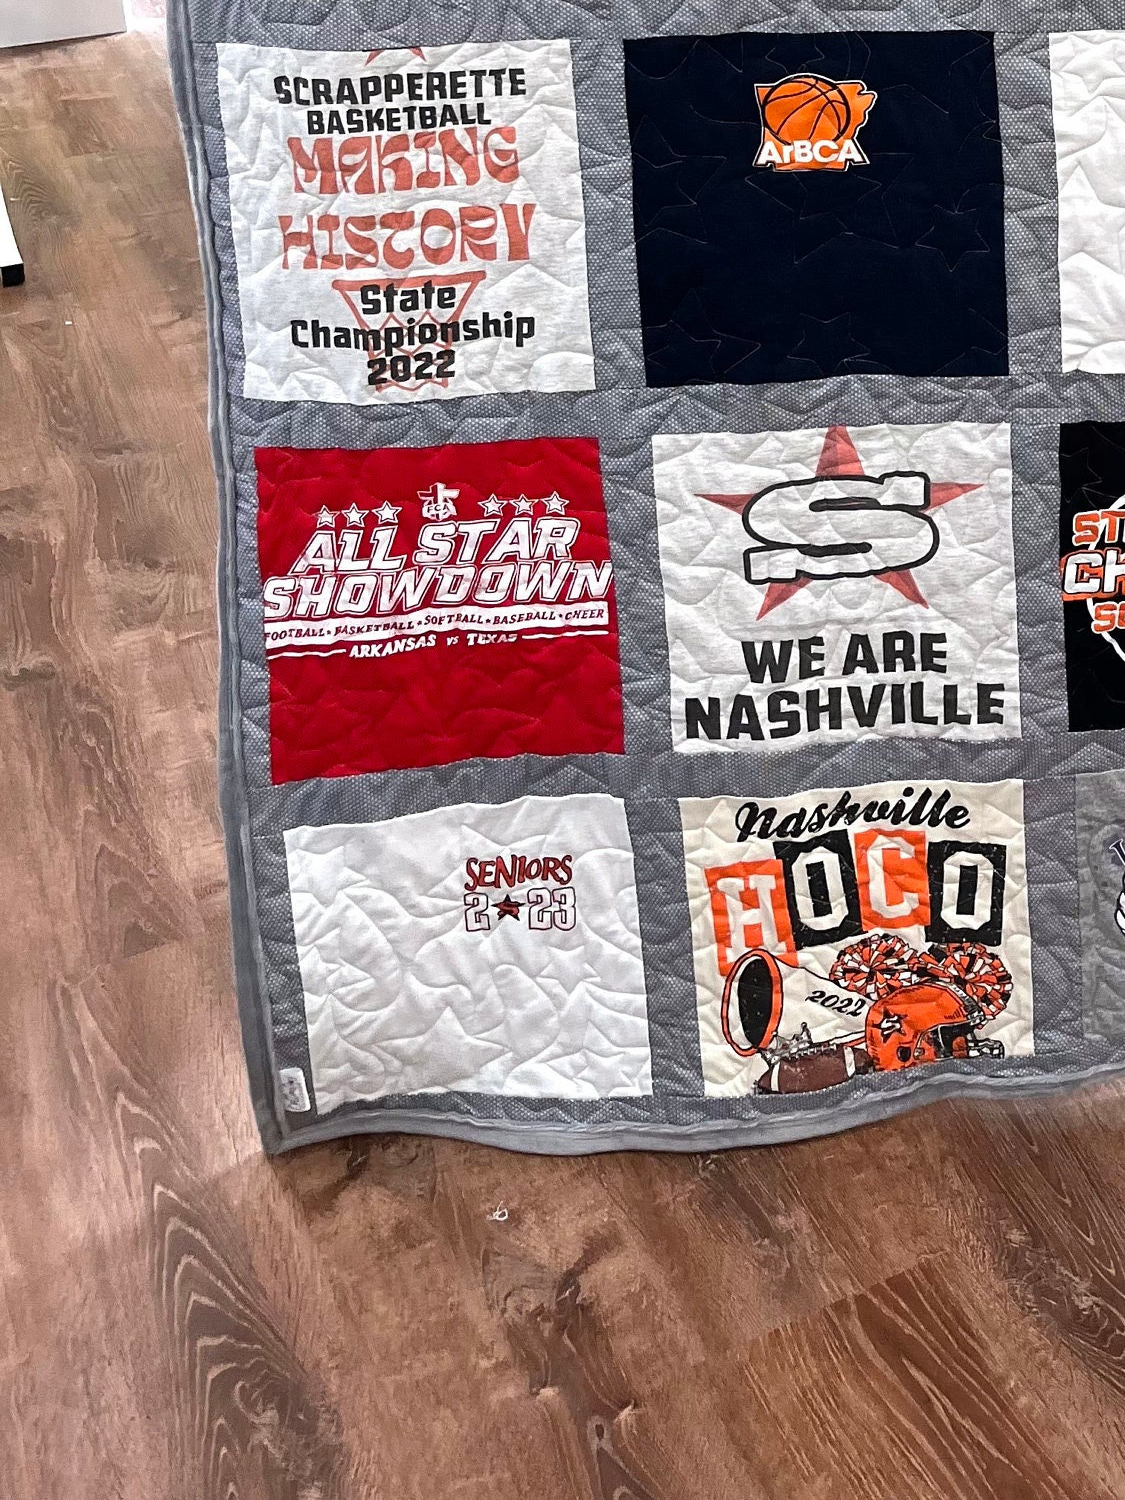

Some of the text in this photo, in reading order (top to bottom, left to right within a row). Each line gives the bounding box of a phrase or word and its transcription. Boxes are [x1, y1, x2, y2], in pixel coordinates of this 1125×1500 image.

[273, 67, 527, 107] SCRAPPERETTE
[306, 103, 492, 135] BASKETBALL
[287, 125, 521, 195] MAKING
[756, 139, 864, 165] ArBCA
[278, 202, 537, 271] HISTORY
[360, 280, 457, 316] State
[291, 310, 535, 357] Championship
[367, 349, 456, 386] 2022
[427, 504, 450, 513] FCA
[288, 516, 581, 576] ALL STAR
[263, 559, 613, 620] SHOWDOWN
[265, 608, 604, 641] FOOTBALL BASKETBALL SOFTBALL BASEBALL CHEER
[348, 633, 518, 659] ARKANSAS TEXAS
[741, 630, 947, 684] WE ARE
[685, 681, 1006, 741] NASHVILLE
[735, 786, 971, 842] Nashville
[464, 854, 573, 891] SENIORS
[712, 833, 996, 964] HOCO
[804, 989, 867, 1018] 2022
